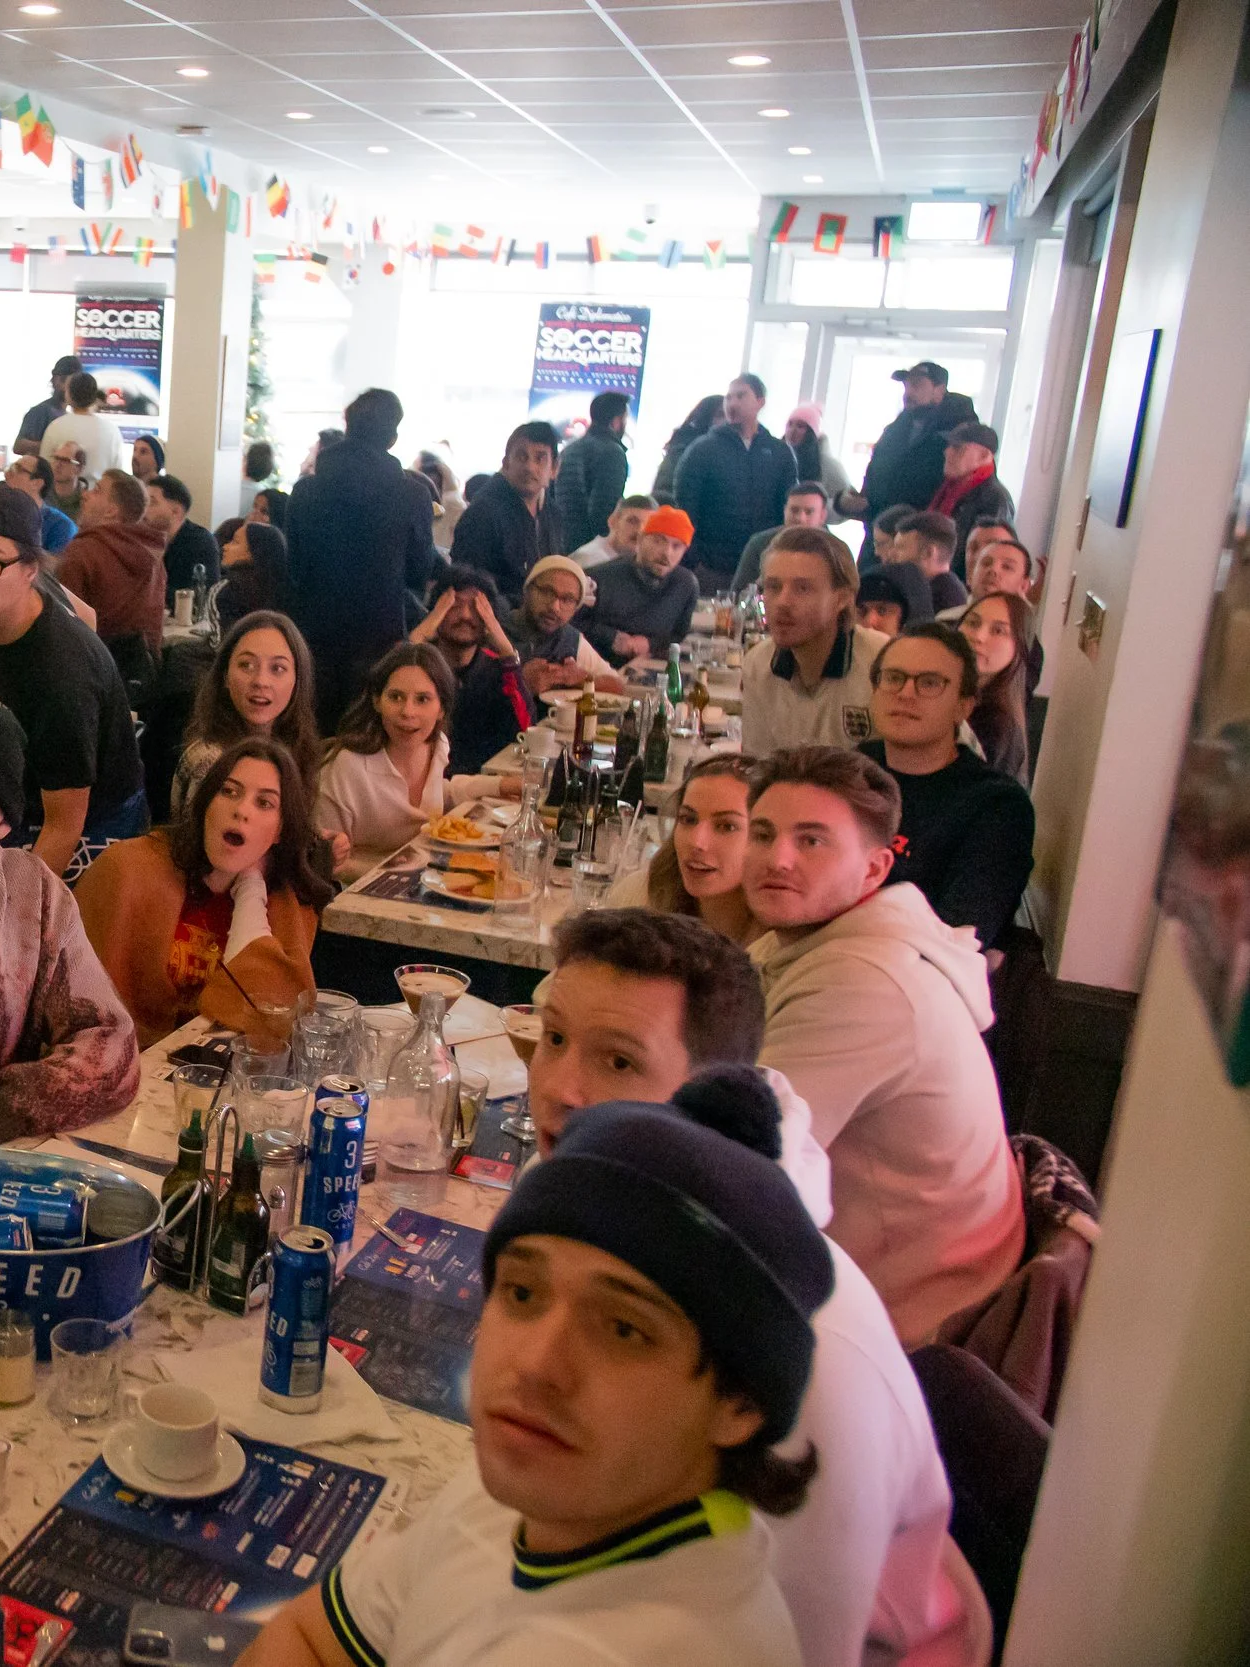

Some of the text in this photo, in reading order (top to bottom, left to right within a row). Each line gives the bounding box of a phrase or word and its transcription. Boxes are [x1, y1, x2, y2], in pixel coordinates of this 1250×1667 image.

[76, 308, 161, 329] SOCCER
[539, 326, 643, 354] SOCCER
[536, 347, 643, 367] HEADQUARTERS
[343, 1140, 357, 1169] 3
